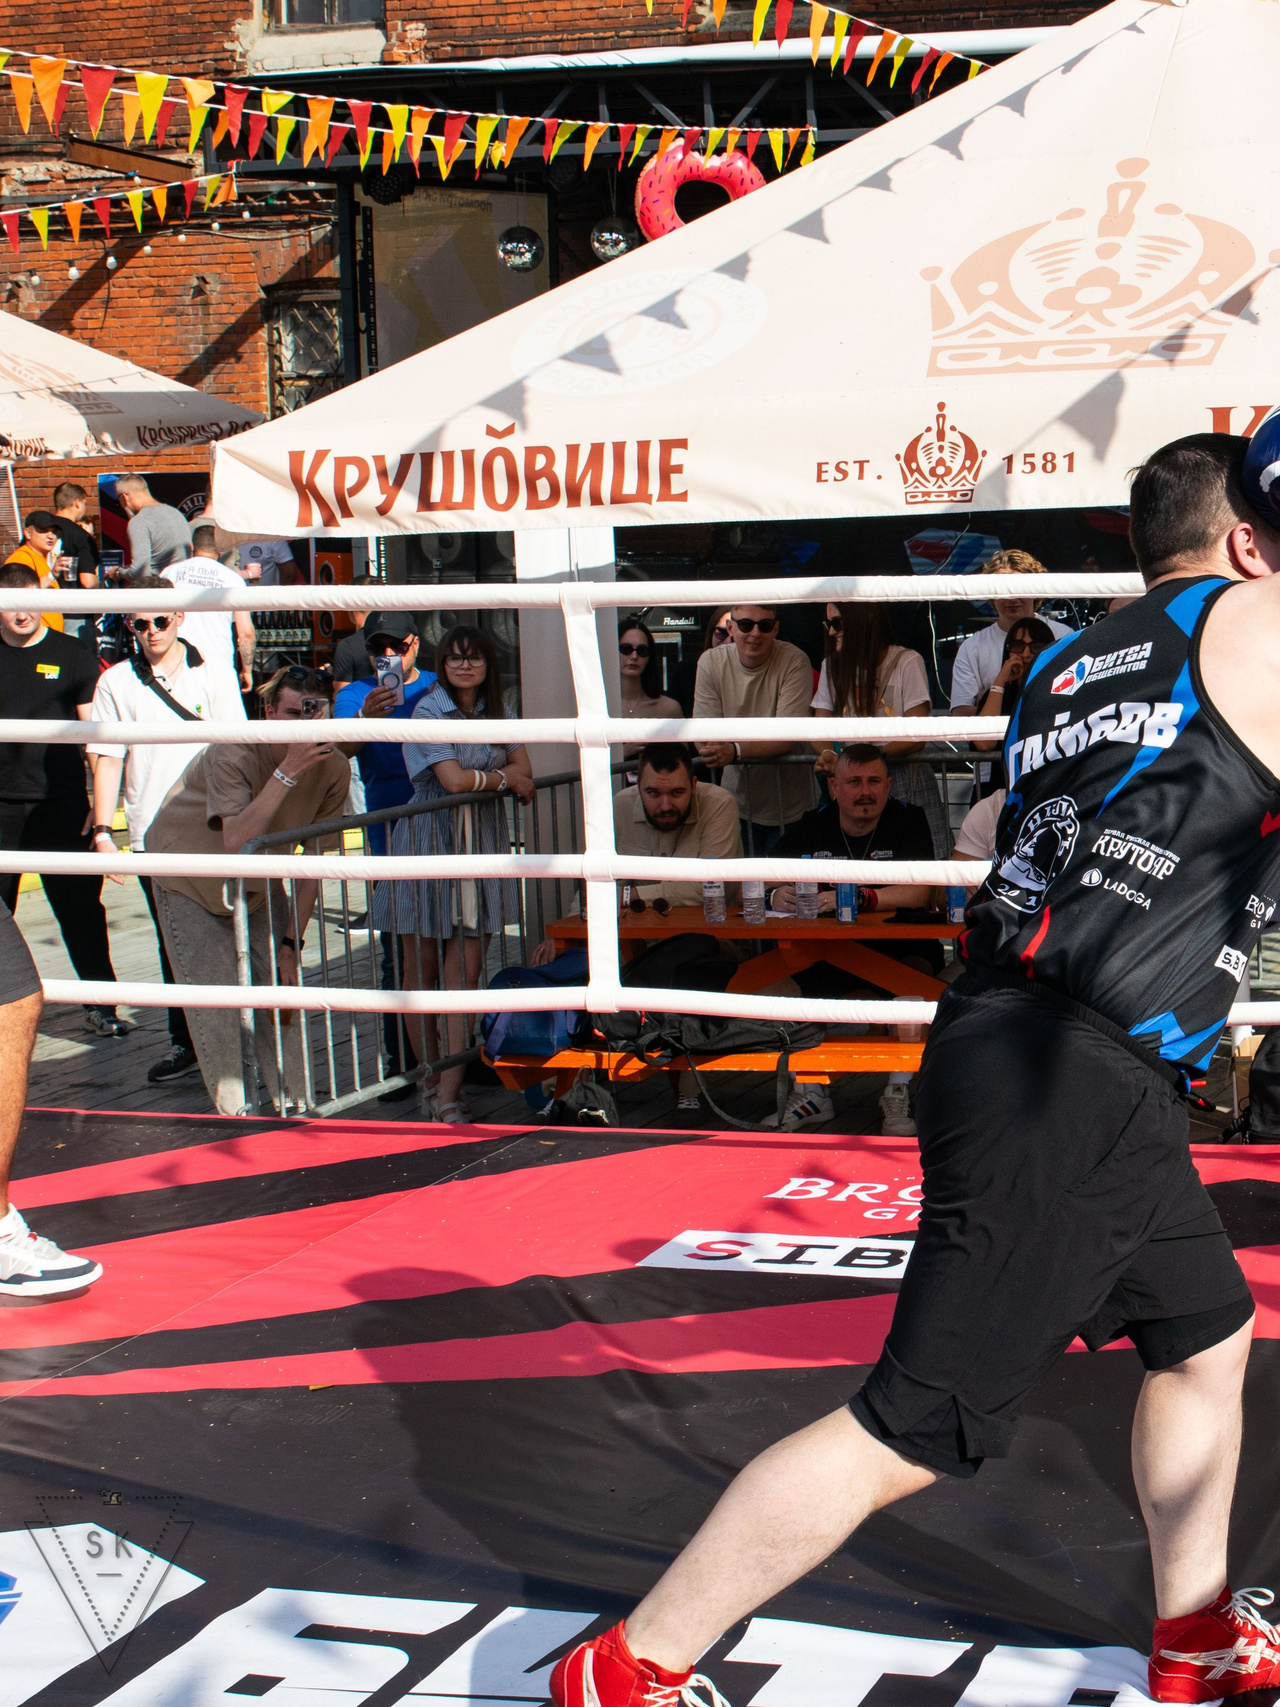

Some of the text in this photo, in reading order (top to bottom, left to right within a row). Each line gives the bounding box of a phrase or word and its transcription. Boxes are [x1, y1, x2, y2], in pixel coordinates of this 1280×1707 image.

[816, 459, 884, 483] EST.
[1002, 451, 1076, 475] 1581
[663, 616, 696, 626] Randall
[1090, 641, 1154, 674] БИТВА
[1091, 834, 1177, 880] КРУТОЯР
[1103, 877, 1152, 911] LADOGA
